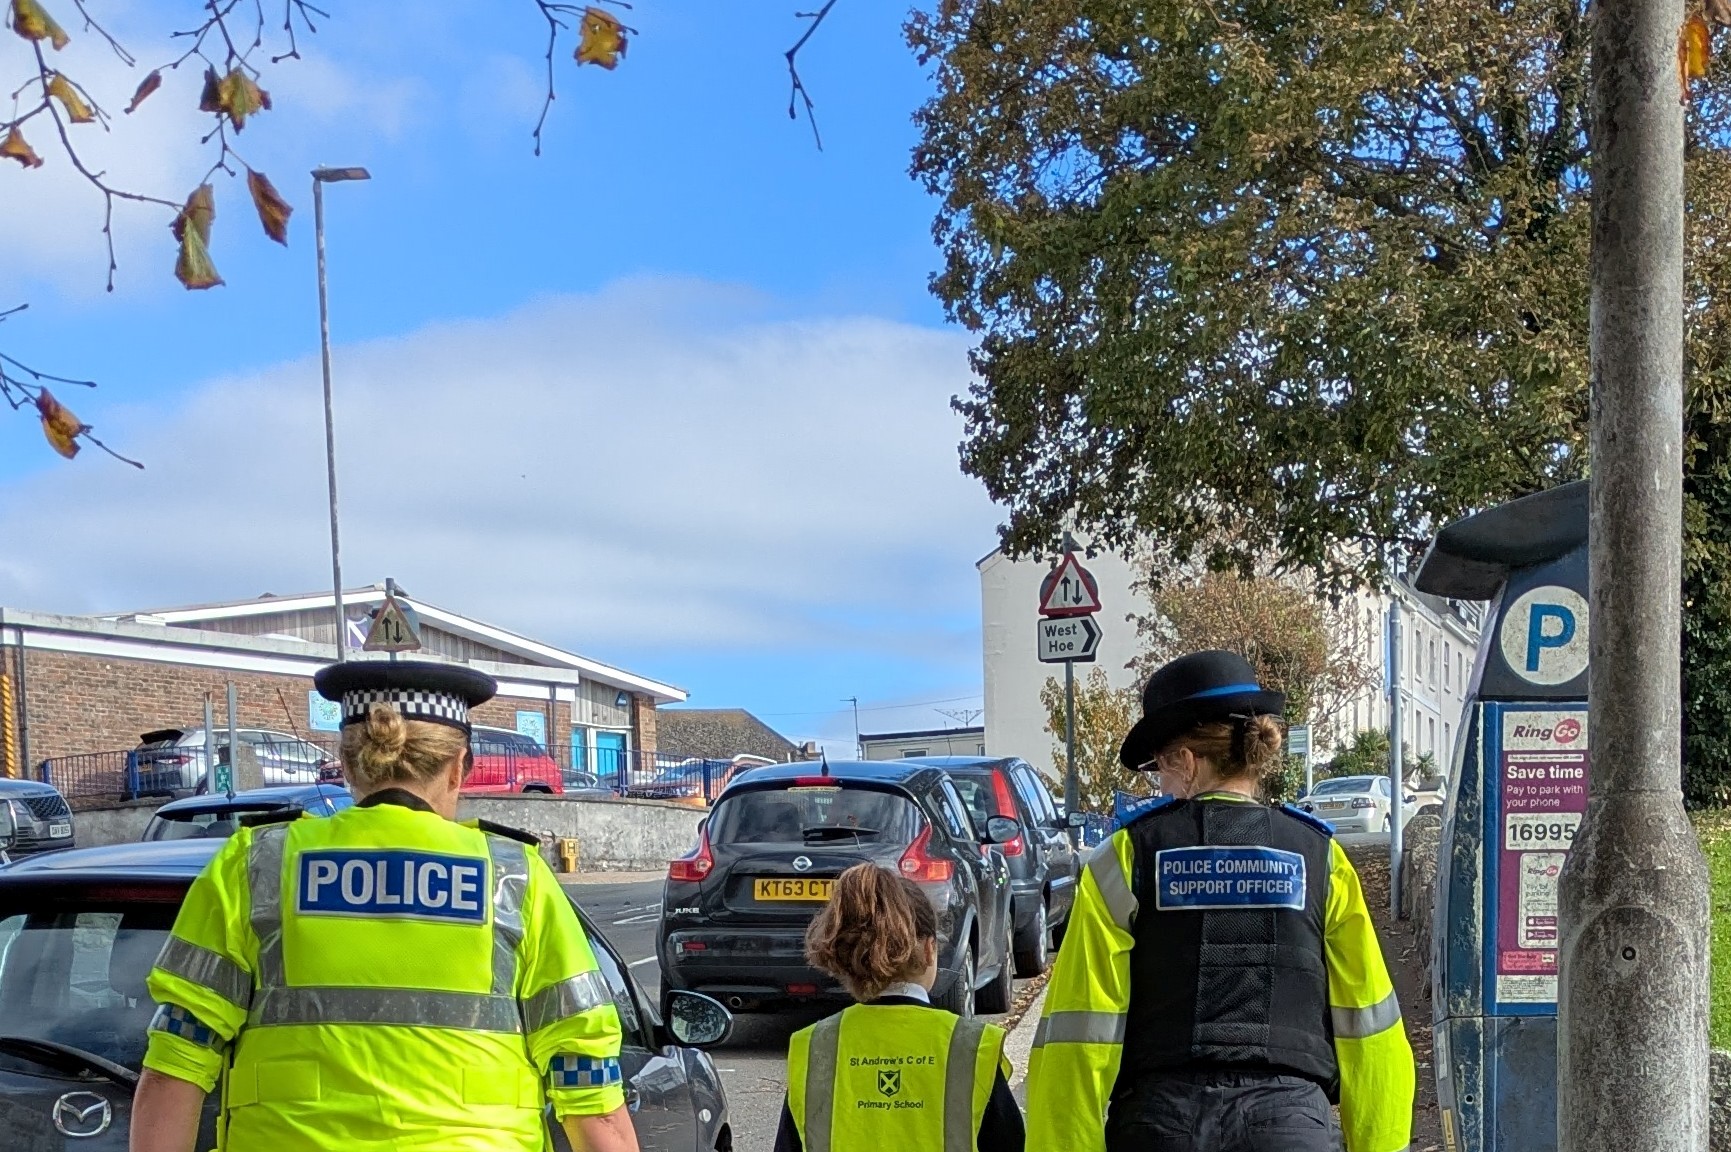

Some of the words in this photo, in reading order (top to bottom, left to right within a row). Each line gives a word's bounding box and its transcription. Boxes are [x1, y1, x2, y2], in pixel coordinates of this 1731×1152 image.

[1044, 623, 1077, 638] West
[1526, 603, 1576, 672] P
[1048, 640, 1074, 653] Hoe
[1513, 722, 1580, 742] RingGo
[1507, 765, 1546, 779] Save
[1549, 764, 1584, 779] time
[1506, 785, 1524, 797] Pay
[1527, 785, 1537, 795] to
[1539, 785, 1561, 796] park
[1562, 785, 1584, 794] with
[1506, 799, 1528, 809] your
[1530, 798, 1560, 808] phone
[1508, 823, 1576, 841] 16995
[1163, 860, 1212, 875] POLICE
[1215, 859, 1299, 876] COMMUNITY
[307, 859, 478, 911] POLICE
[761, 880, 805, 897] KT63
[808, 880, 835, 897] CT
[1169, 880, 1234, 896] SUPPORT
[1236, 879, 1293, 894] OFFICER
[849, 1057, 859, 1067] St
[861, 1056, 904, 1066] Andrew's
[906, 1055, 914, 1065] C
[916, 1056, 926, 1065] of
[928, 1056, 935, 1065] E
[857, 1100, 892, 1111] Primary
[893, 1100, 924, 1109] School
